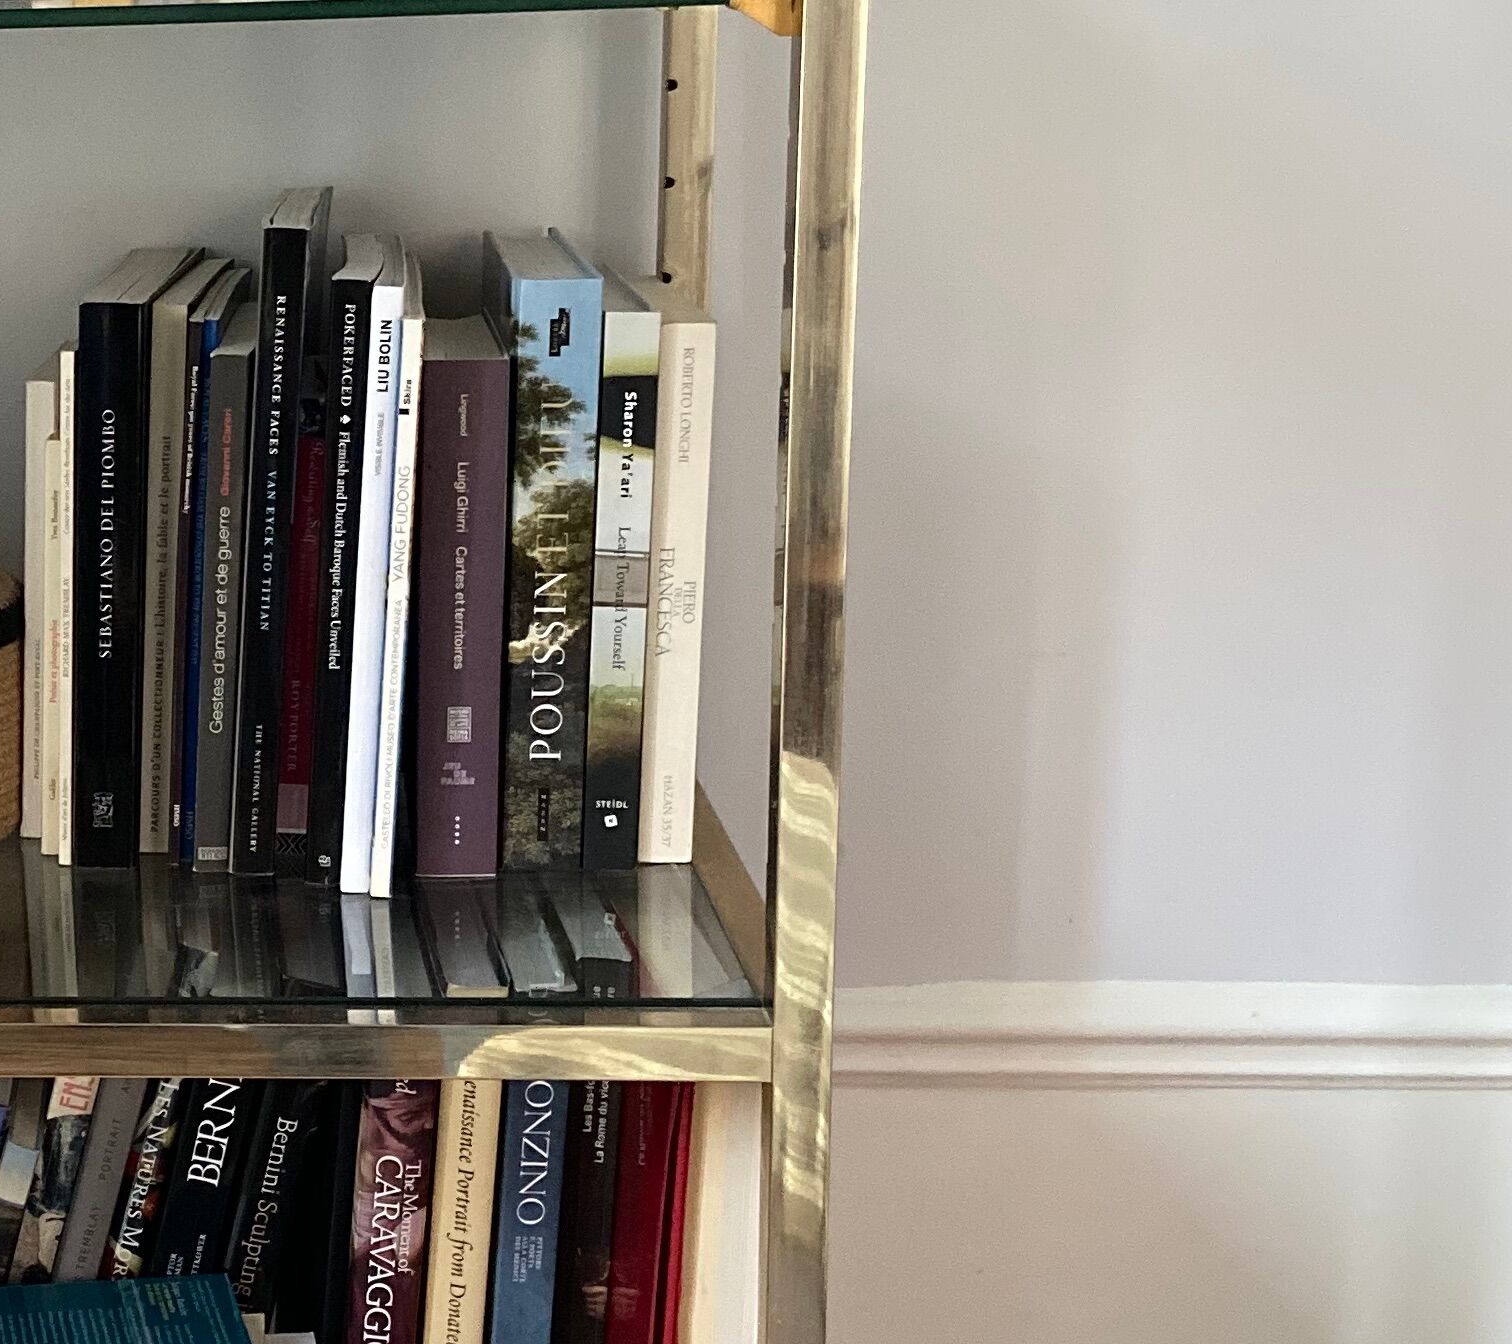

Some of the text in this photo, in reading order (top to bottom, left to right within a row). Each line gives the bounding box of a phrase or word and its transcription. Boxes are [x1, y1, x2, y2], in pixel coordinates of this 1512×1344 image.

[376, 318, 392, 393] LIU BOLIN
[400, 378, 413, 405] Skira
[677, 346, 695, 463] ROBERTO LONGHI
[258, 295, 286, 631] RENAISSANCE FACES VAN EYCK TO TITIAN
[328, 303, 357, 669] POKERFACED Flemish and Dutch Baroque Faces Unveiled
[97, 407, 116, 659] SEBASTIANO DEL PIOMBO
[390, 464, 412, 583] YANG FUDONG
[453, 461, 469, 670] Luigi Ghirri Cartes et territoires
[208, 505, 232, 734] Gestes d'amour et de guerre
[653, 545, 675, 658] FRANCESCA
[682, 579, 696, 624] PIERO
[595, 799, 630, 809] STEIDL
[456, 1079, 480, 1164] enaissance
[230, 1115, 299, 1299] Bernini Sculpting
[396, 1159, 421, 1276] The Moment of
[443, 1237, 473, 1278] from
[451, 1167, 475, 1234] Portrait
